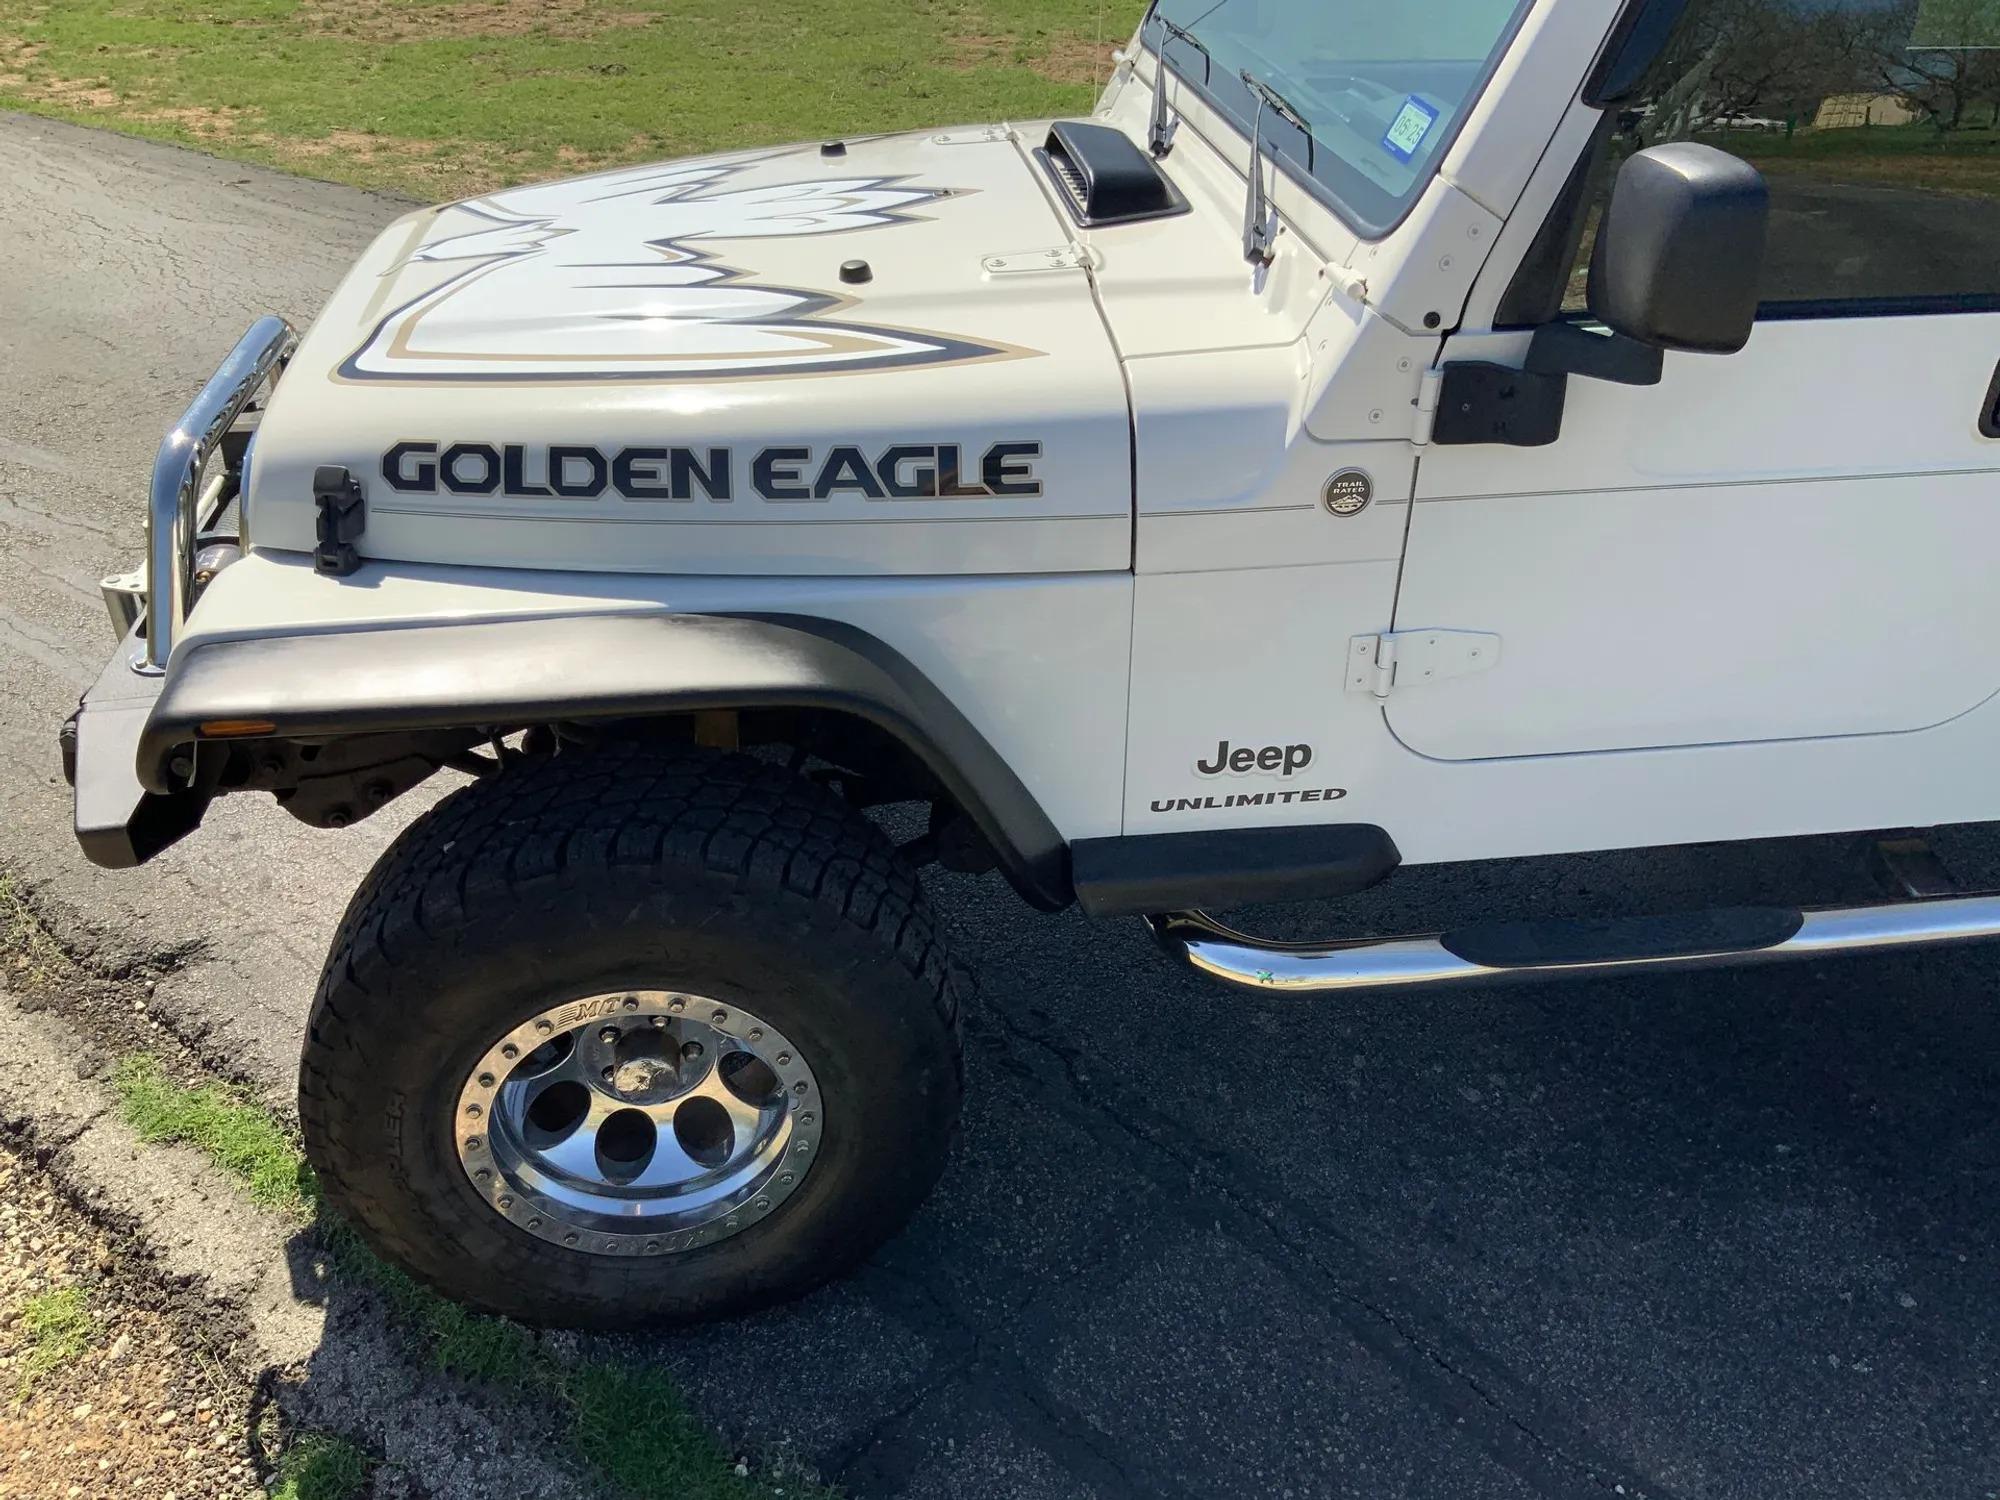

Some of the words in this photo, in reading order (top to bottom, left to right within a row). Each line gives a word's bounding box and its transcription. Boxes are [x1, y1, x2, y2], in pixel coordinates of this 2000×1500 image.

[381, 440, 732, 502] GOLDEN
[751, 441, 1042, 502] EAGLE
[1196, 740, 1313, 776] Jeep
[1150, 788, 1348, 813] UNLIMITED
